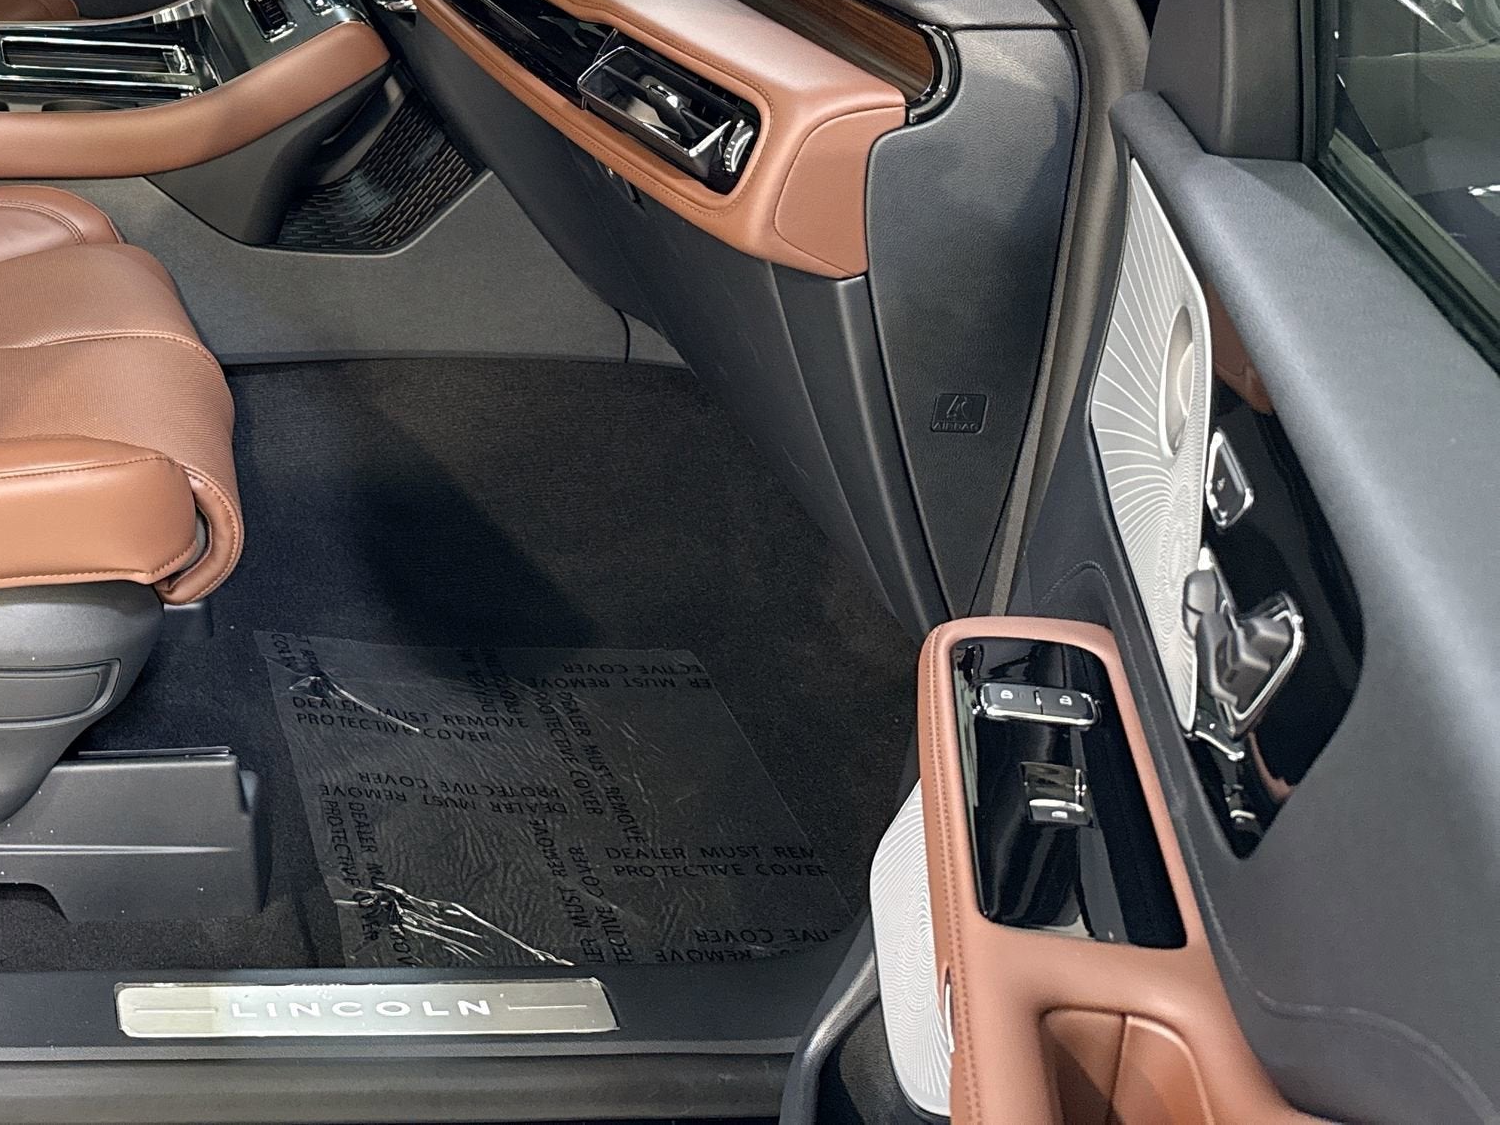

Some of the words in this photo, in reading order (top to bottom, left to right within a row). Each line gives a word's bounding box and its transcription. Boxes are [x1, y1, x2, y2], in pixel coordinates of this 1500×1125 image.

[562, 663, 629, 676] COVER
[621, 677, 676, 689] MUST
[292, 696, 364, 714] DEALER
[377, 706, 430, 724] MUST
[443, 711, 529, 729] REMOVE
[297, 712, 419, 737] PROTECTIVE
[423, 727, 492, 742] COVER
[556, 691, 591, 738] DEALER
[584, 744, 616, 783] MUST
[606, 786, 647, 845] REMOVE
[358, 772, 429, 791] COVER
[440, 780, 561, 799] PROTECTIVE
[321, 785, 408, 803] REMOVE
[423, 795, 478, 810] MUST
[570, 770, 604, 816] COVER
[348, 801, 378, 853] DEALER
[324, 800, 362, 888] PROTECTIVE
[529, 818, 568, 877] REMOVE
[605, 846, 687, 860] DEALER
[700, 845, 760, 860] MUST
[568, 846, 605, 899] COVER
[613, 865, 746, 878] PROTECTIVE
[557, 886, 591, 929] MUST
[695, 928, 774, 944] COVER
[231, 1000, 492, 1019] LINCOLN
